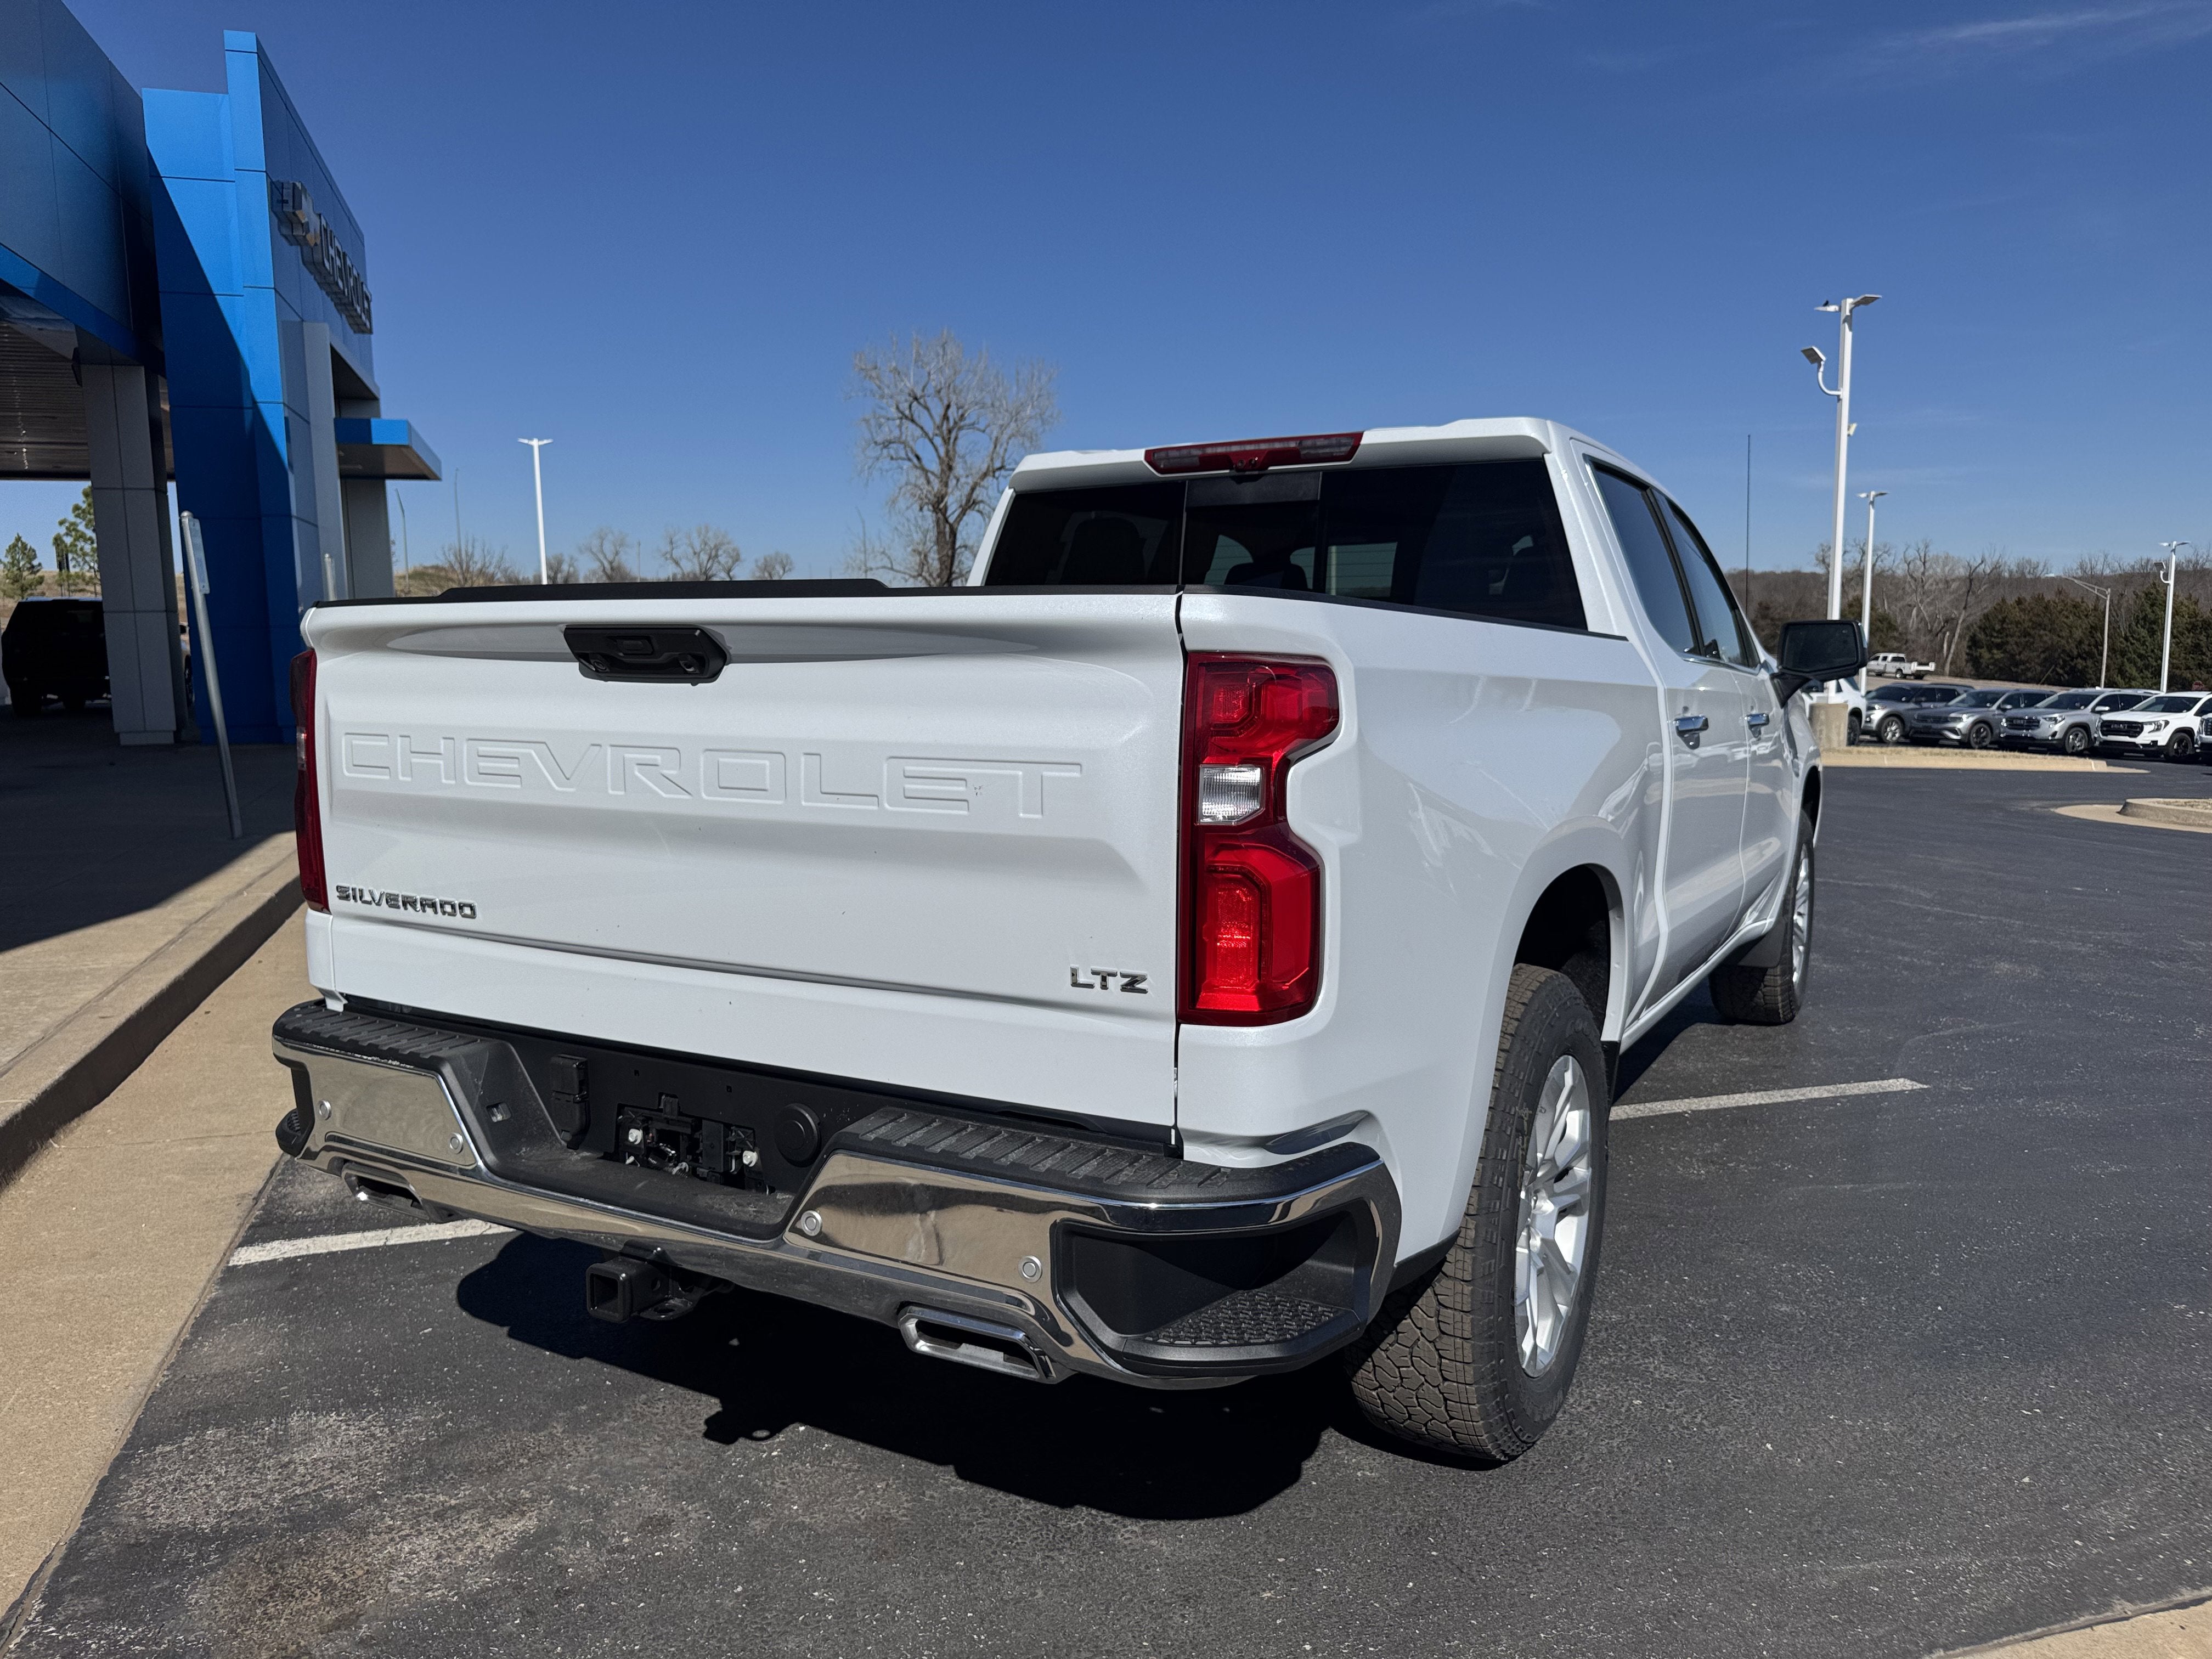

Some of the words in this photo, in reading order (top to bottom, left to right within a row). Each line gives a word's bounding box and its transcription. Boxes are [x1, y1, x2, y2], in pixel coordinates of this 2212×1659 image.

[342, 732, 1082, 818] CHEVROLET
[336, 884, 477, 919] SILVERADO
[1070, 964, 1148, 994] LTZ
